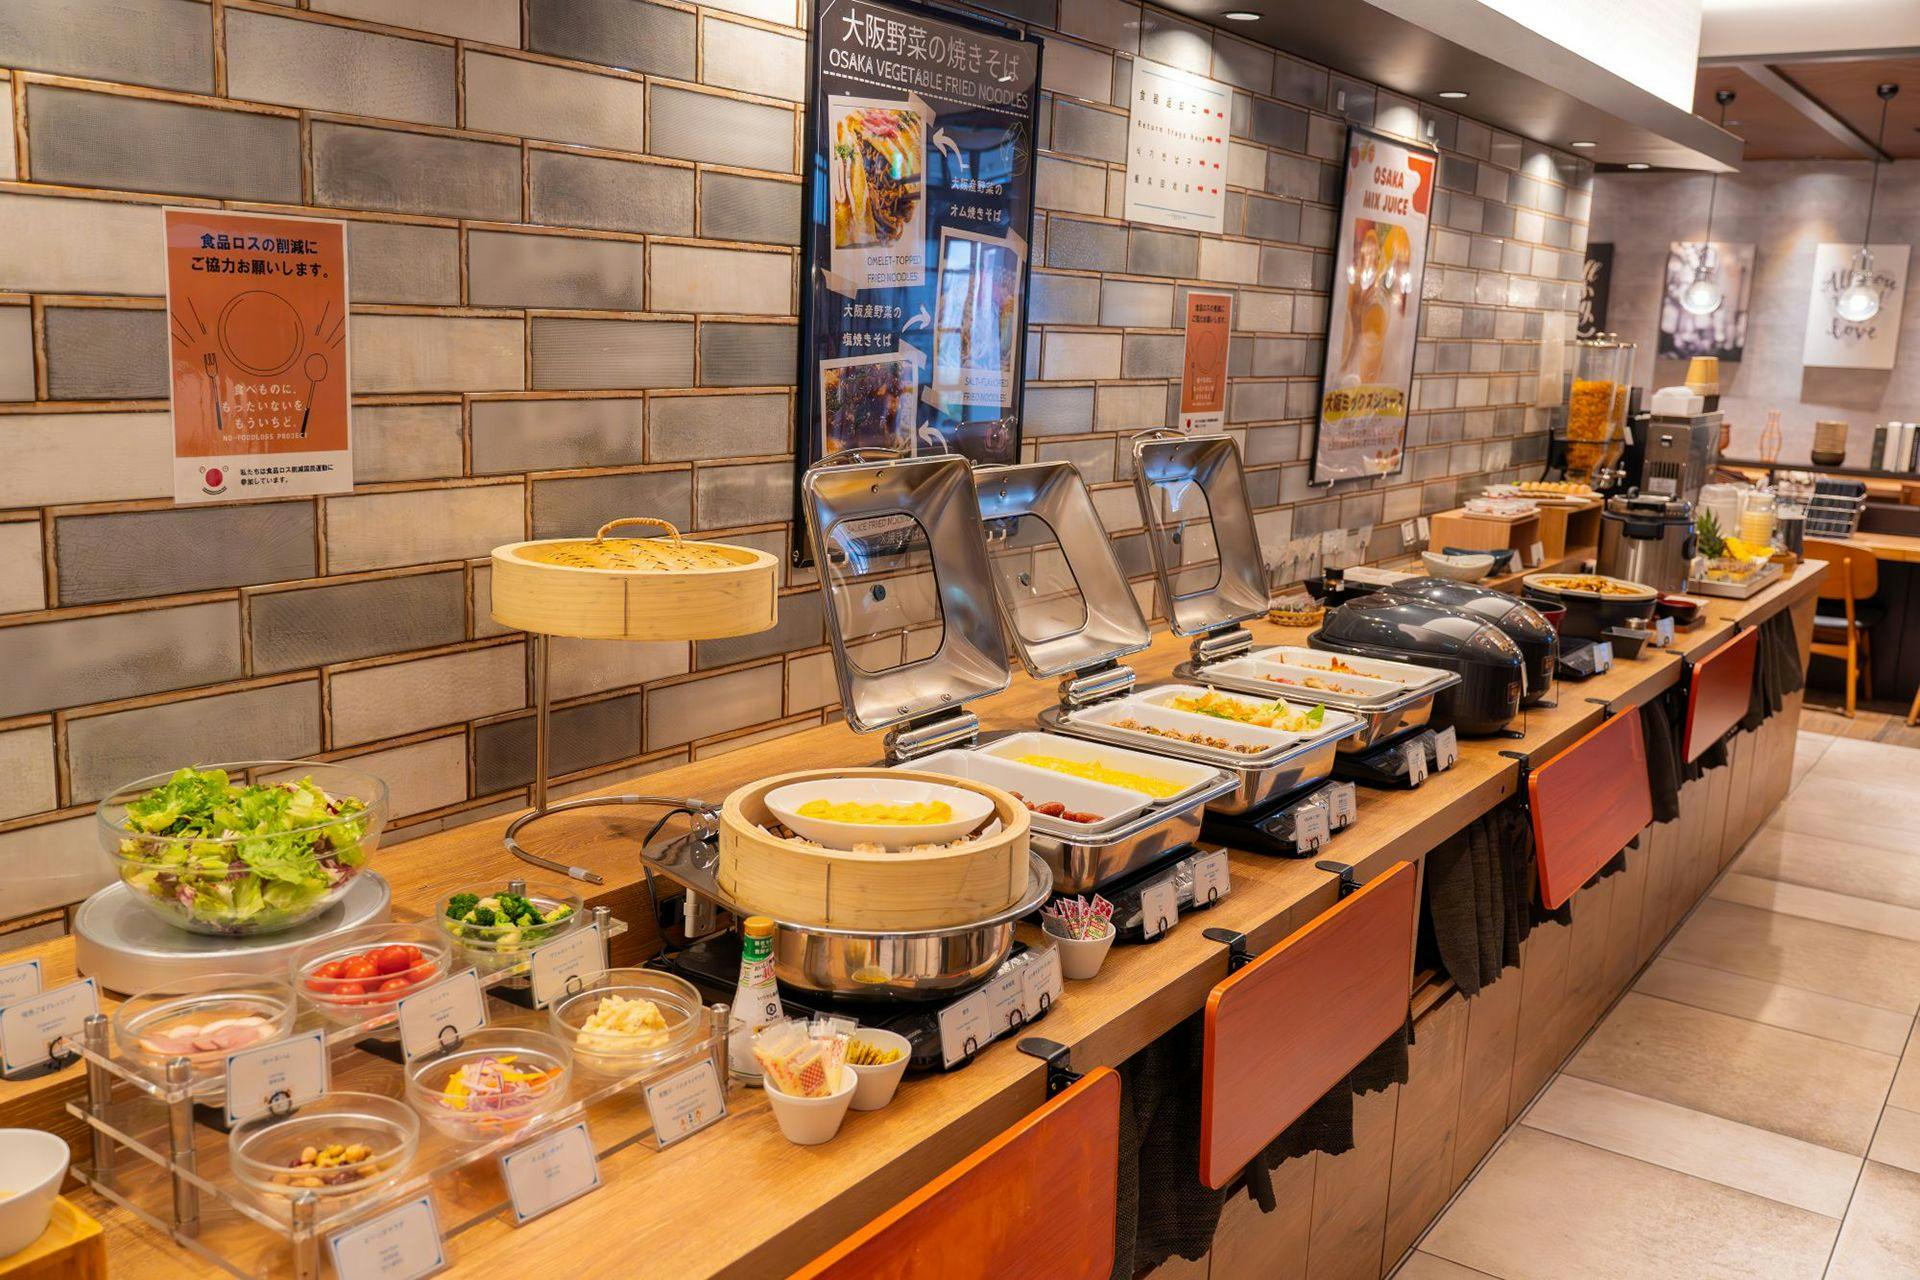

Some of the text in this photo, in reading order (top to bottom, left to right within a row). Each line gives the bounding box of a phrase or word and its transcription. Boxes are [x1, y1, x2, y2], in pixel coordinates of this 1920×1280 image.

[842, 8, 1020, 82] 大阪野菜の焼きそば
[829, 48, 1028, 110] OSAKA VEGETABLE FRIED NOODLES
[951, 175, 1003, 196] 大阪産野菜の
[1373, 165, 1404, 190] OSAKA
[950, 203, 1002, 223] オム焼きそば
[1363, 190, 1408, 216] MIX JUICE
[200, 232, 319, 255] 食品ロスの削減に
[191, 256, 329, 280] ご協力お願いします。
[843, 303, 902, 319] 大阪産野菜の
[842, 332, 892, 347] 塩焼きそば
